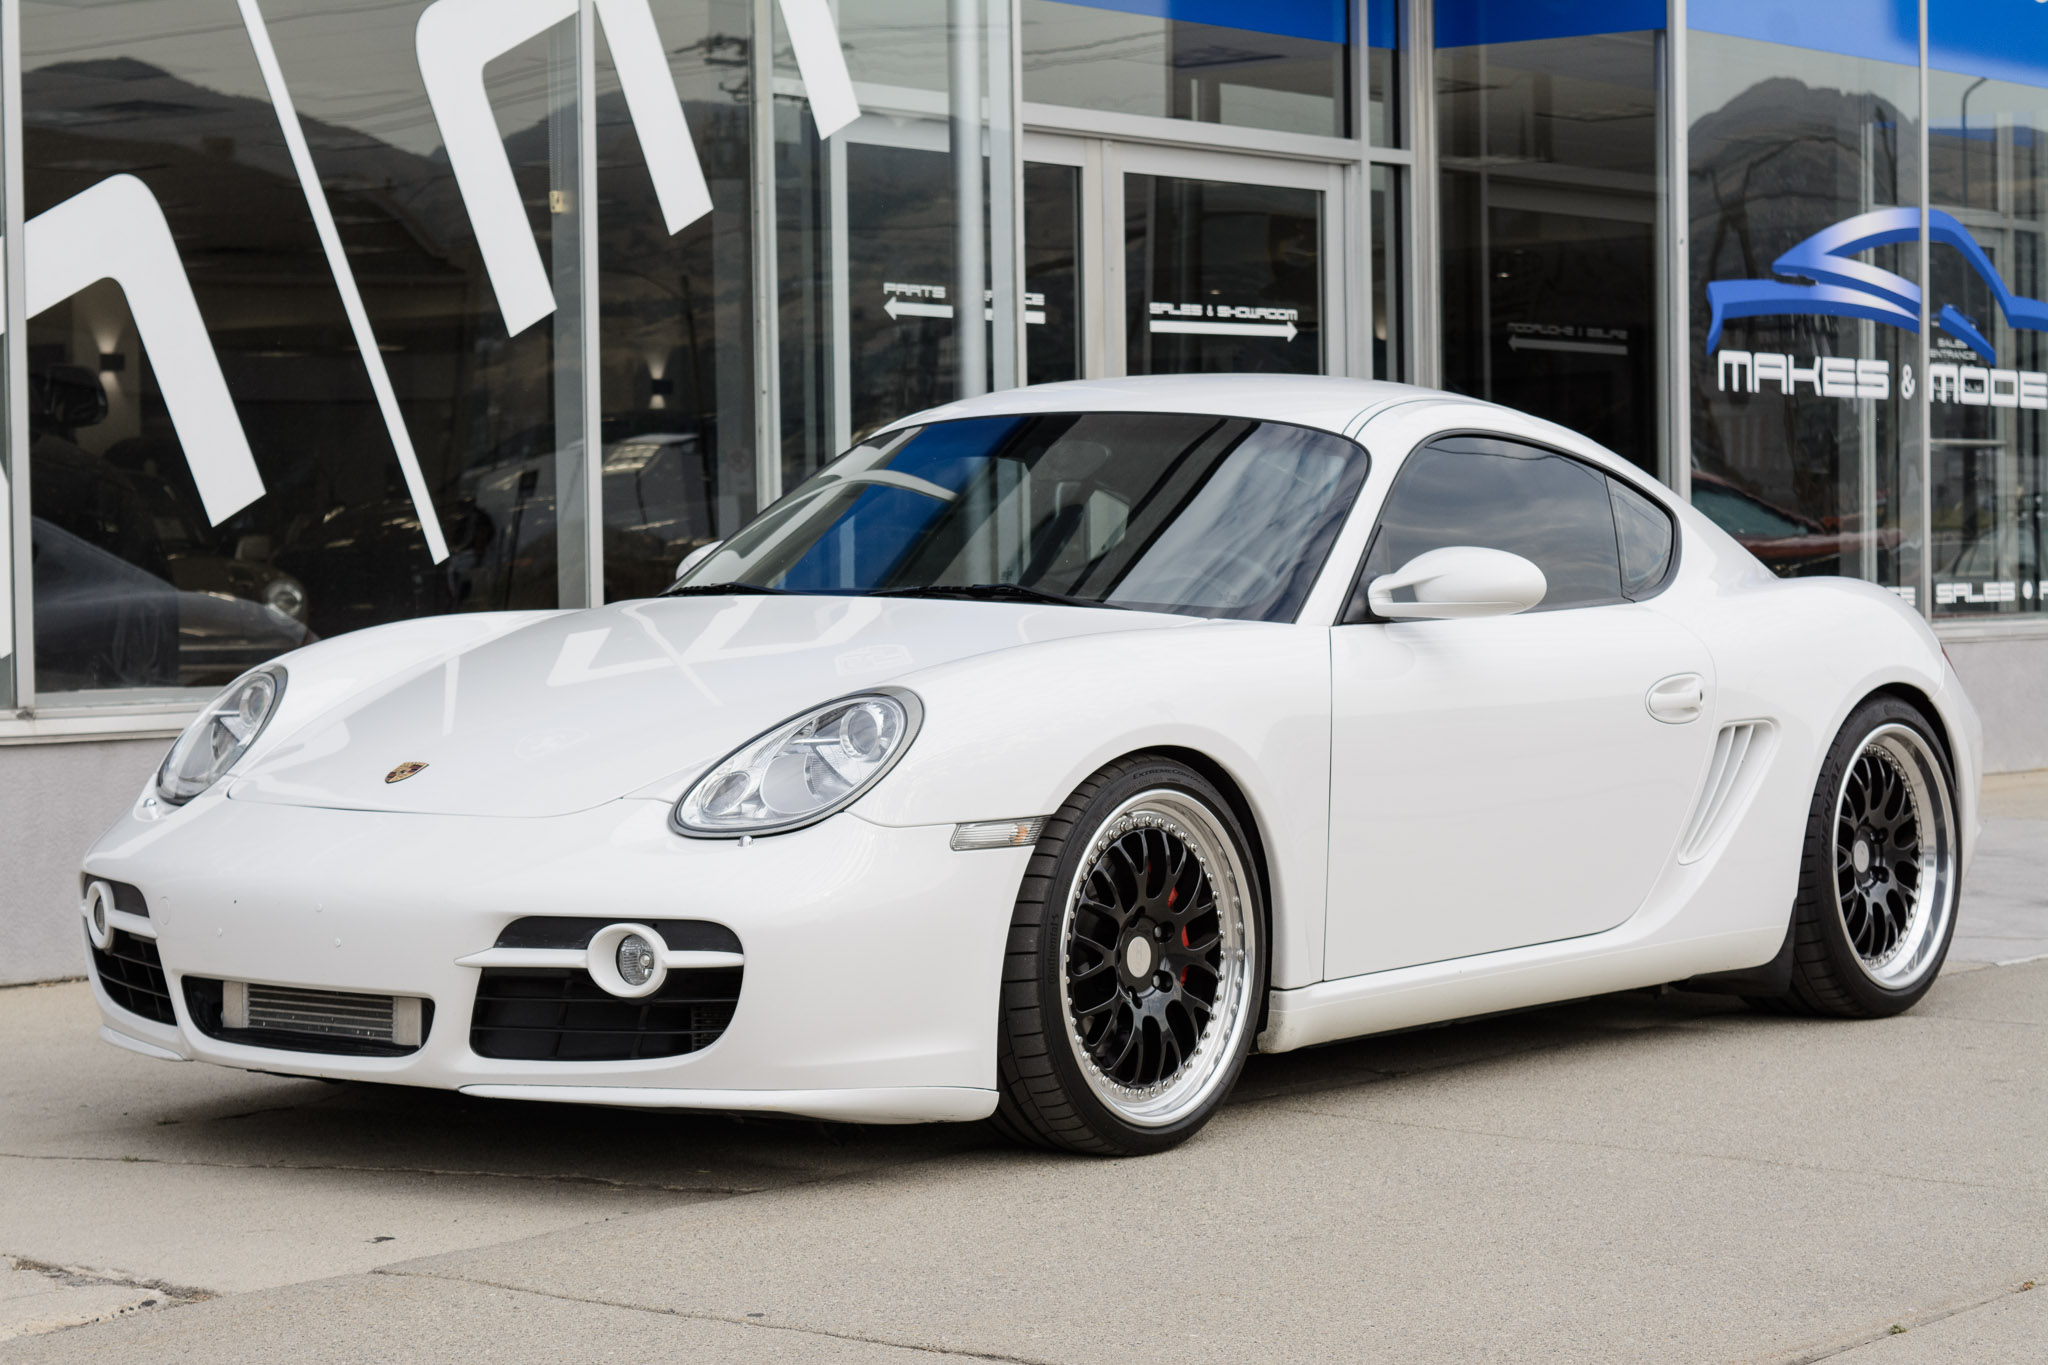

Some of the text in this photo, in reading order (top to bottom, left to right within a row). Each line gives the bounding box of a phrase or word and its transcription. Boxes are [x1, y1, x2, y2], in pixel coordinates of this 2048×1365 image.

[883, 282, 946, 299] PARTS
[1149, 302, 1203, 317] SALES
[1217, 305, 1299, 321] SHOWROOM
[1718, 350, 1890, 400] MAKES
[1900, 364, 1916, 400] &
[1936, 581, 2016, 604] SALES
